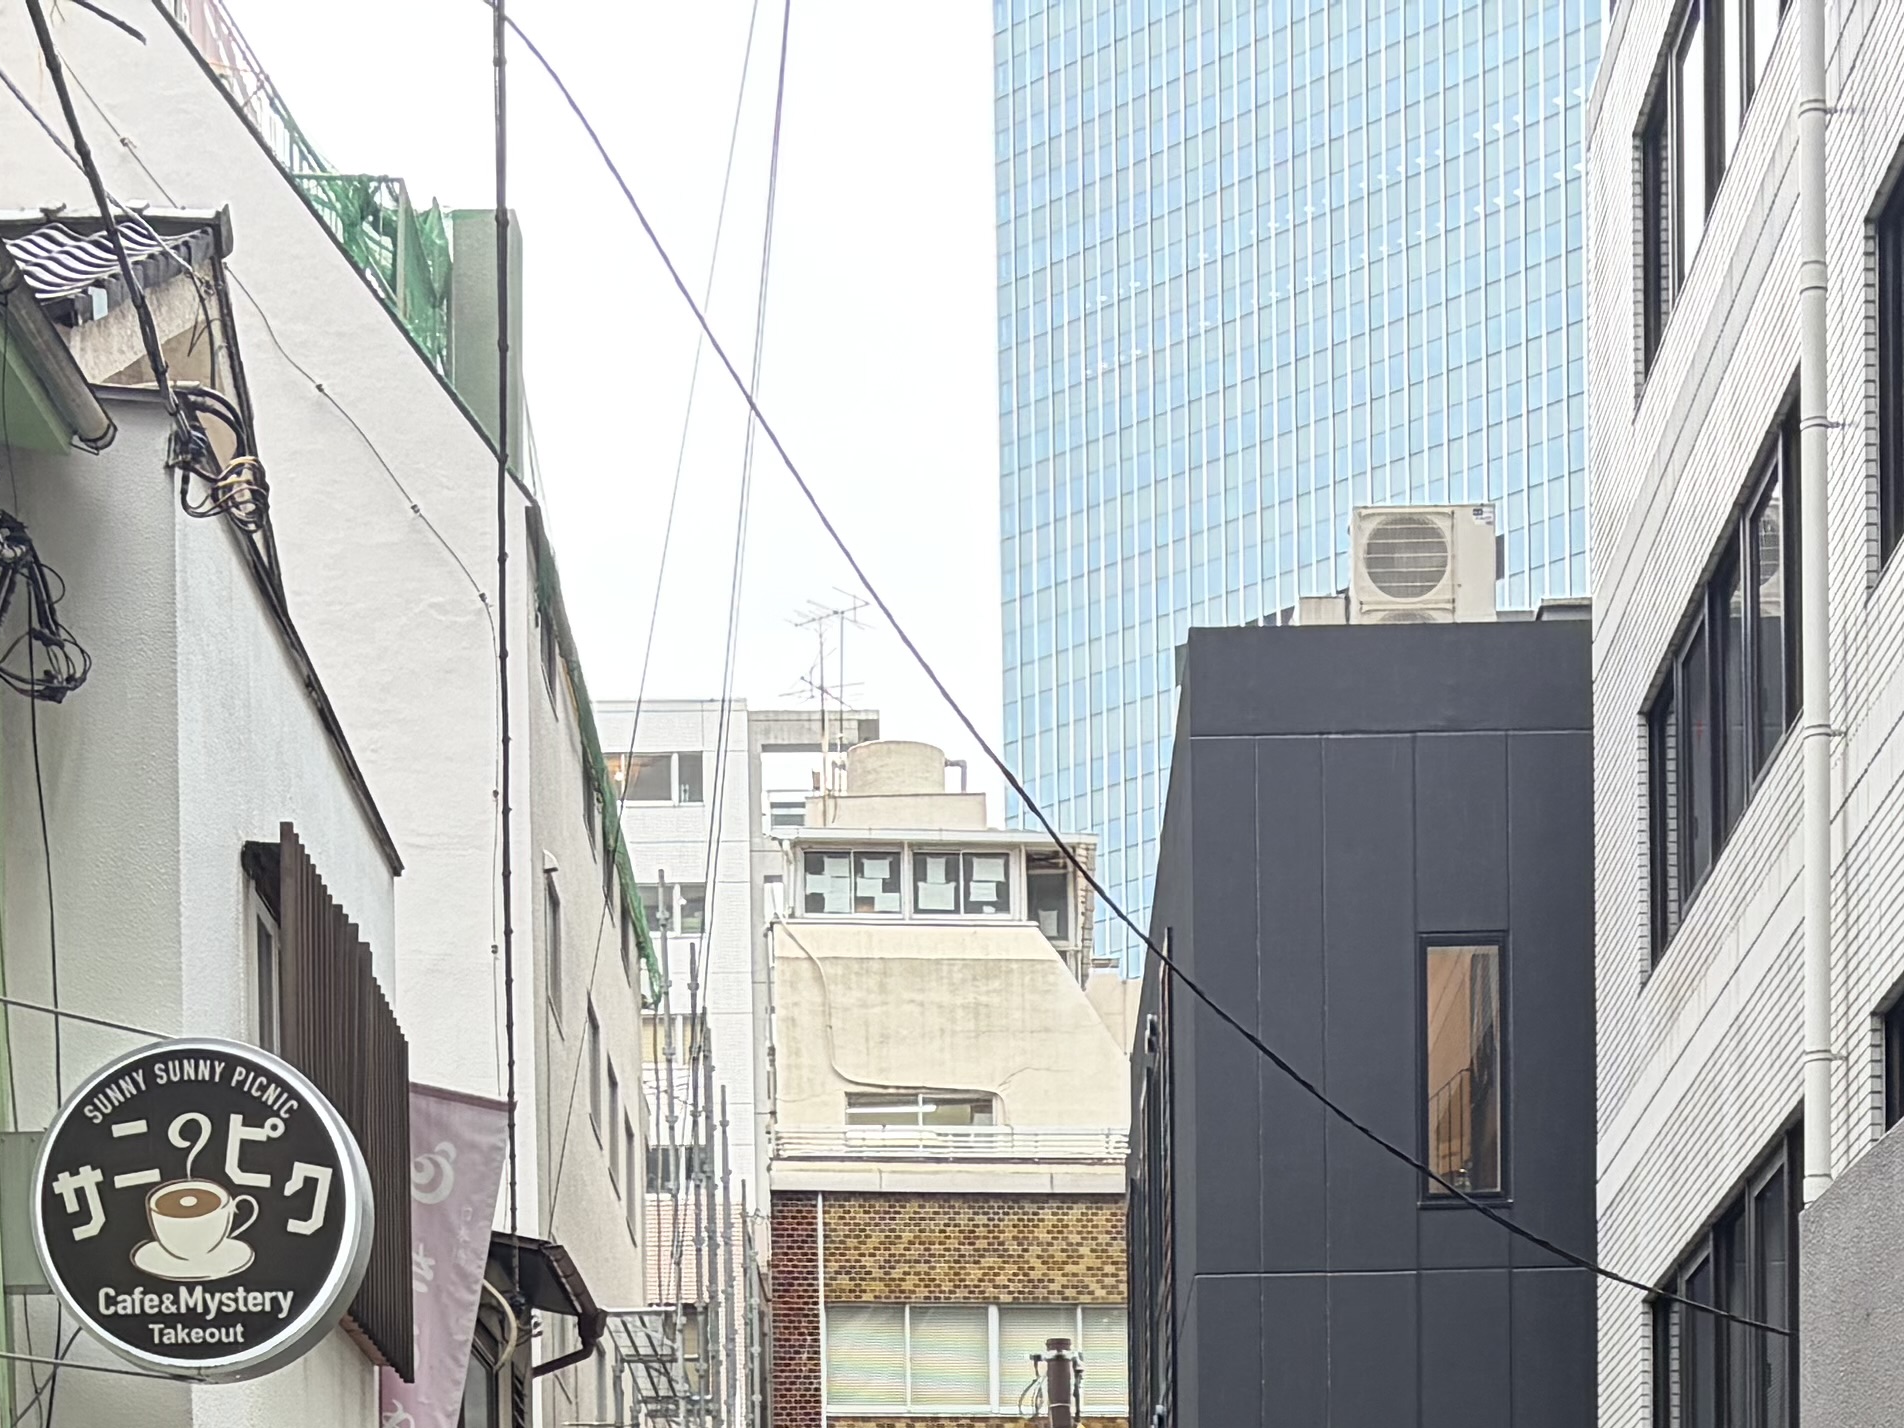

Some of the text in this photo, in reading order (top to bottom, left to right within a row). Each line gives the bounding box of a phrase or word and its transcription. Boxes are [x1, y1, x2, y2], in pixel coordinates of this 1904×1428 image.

[83, 1059, 299, 1124] SUNNY SUNNY PICNIC
[98, 1286, 294, 1320] Cafe&Mystery
[148, 1322, 245, 1344] Takeout
